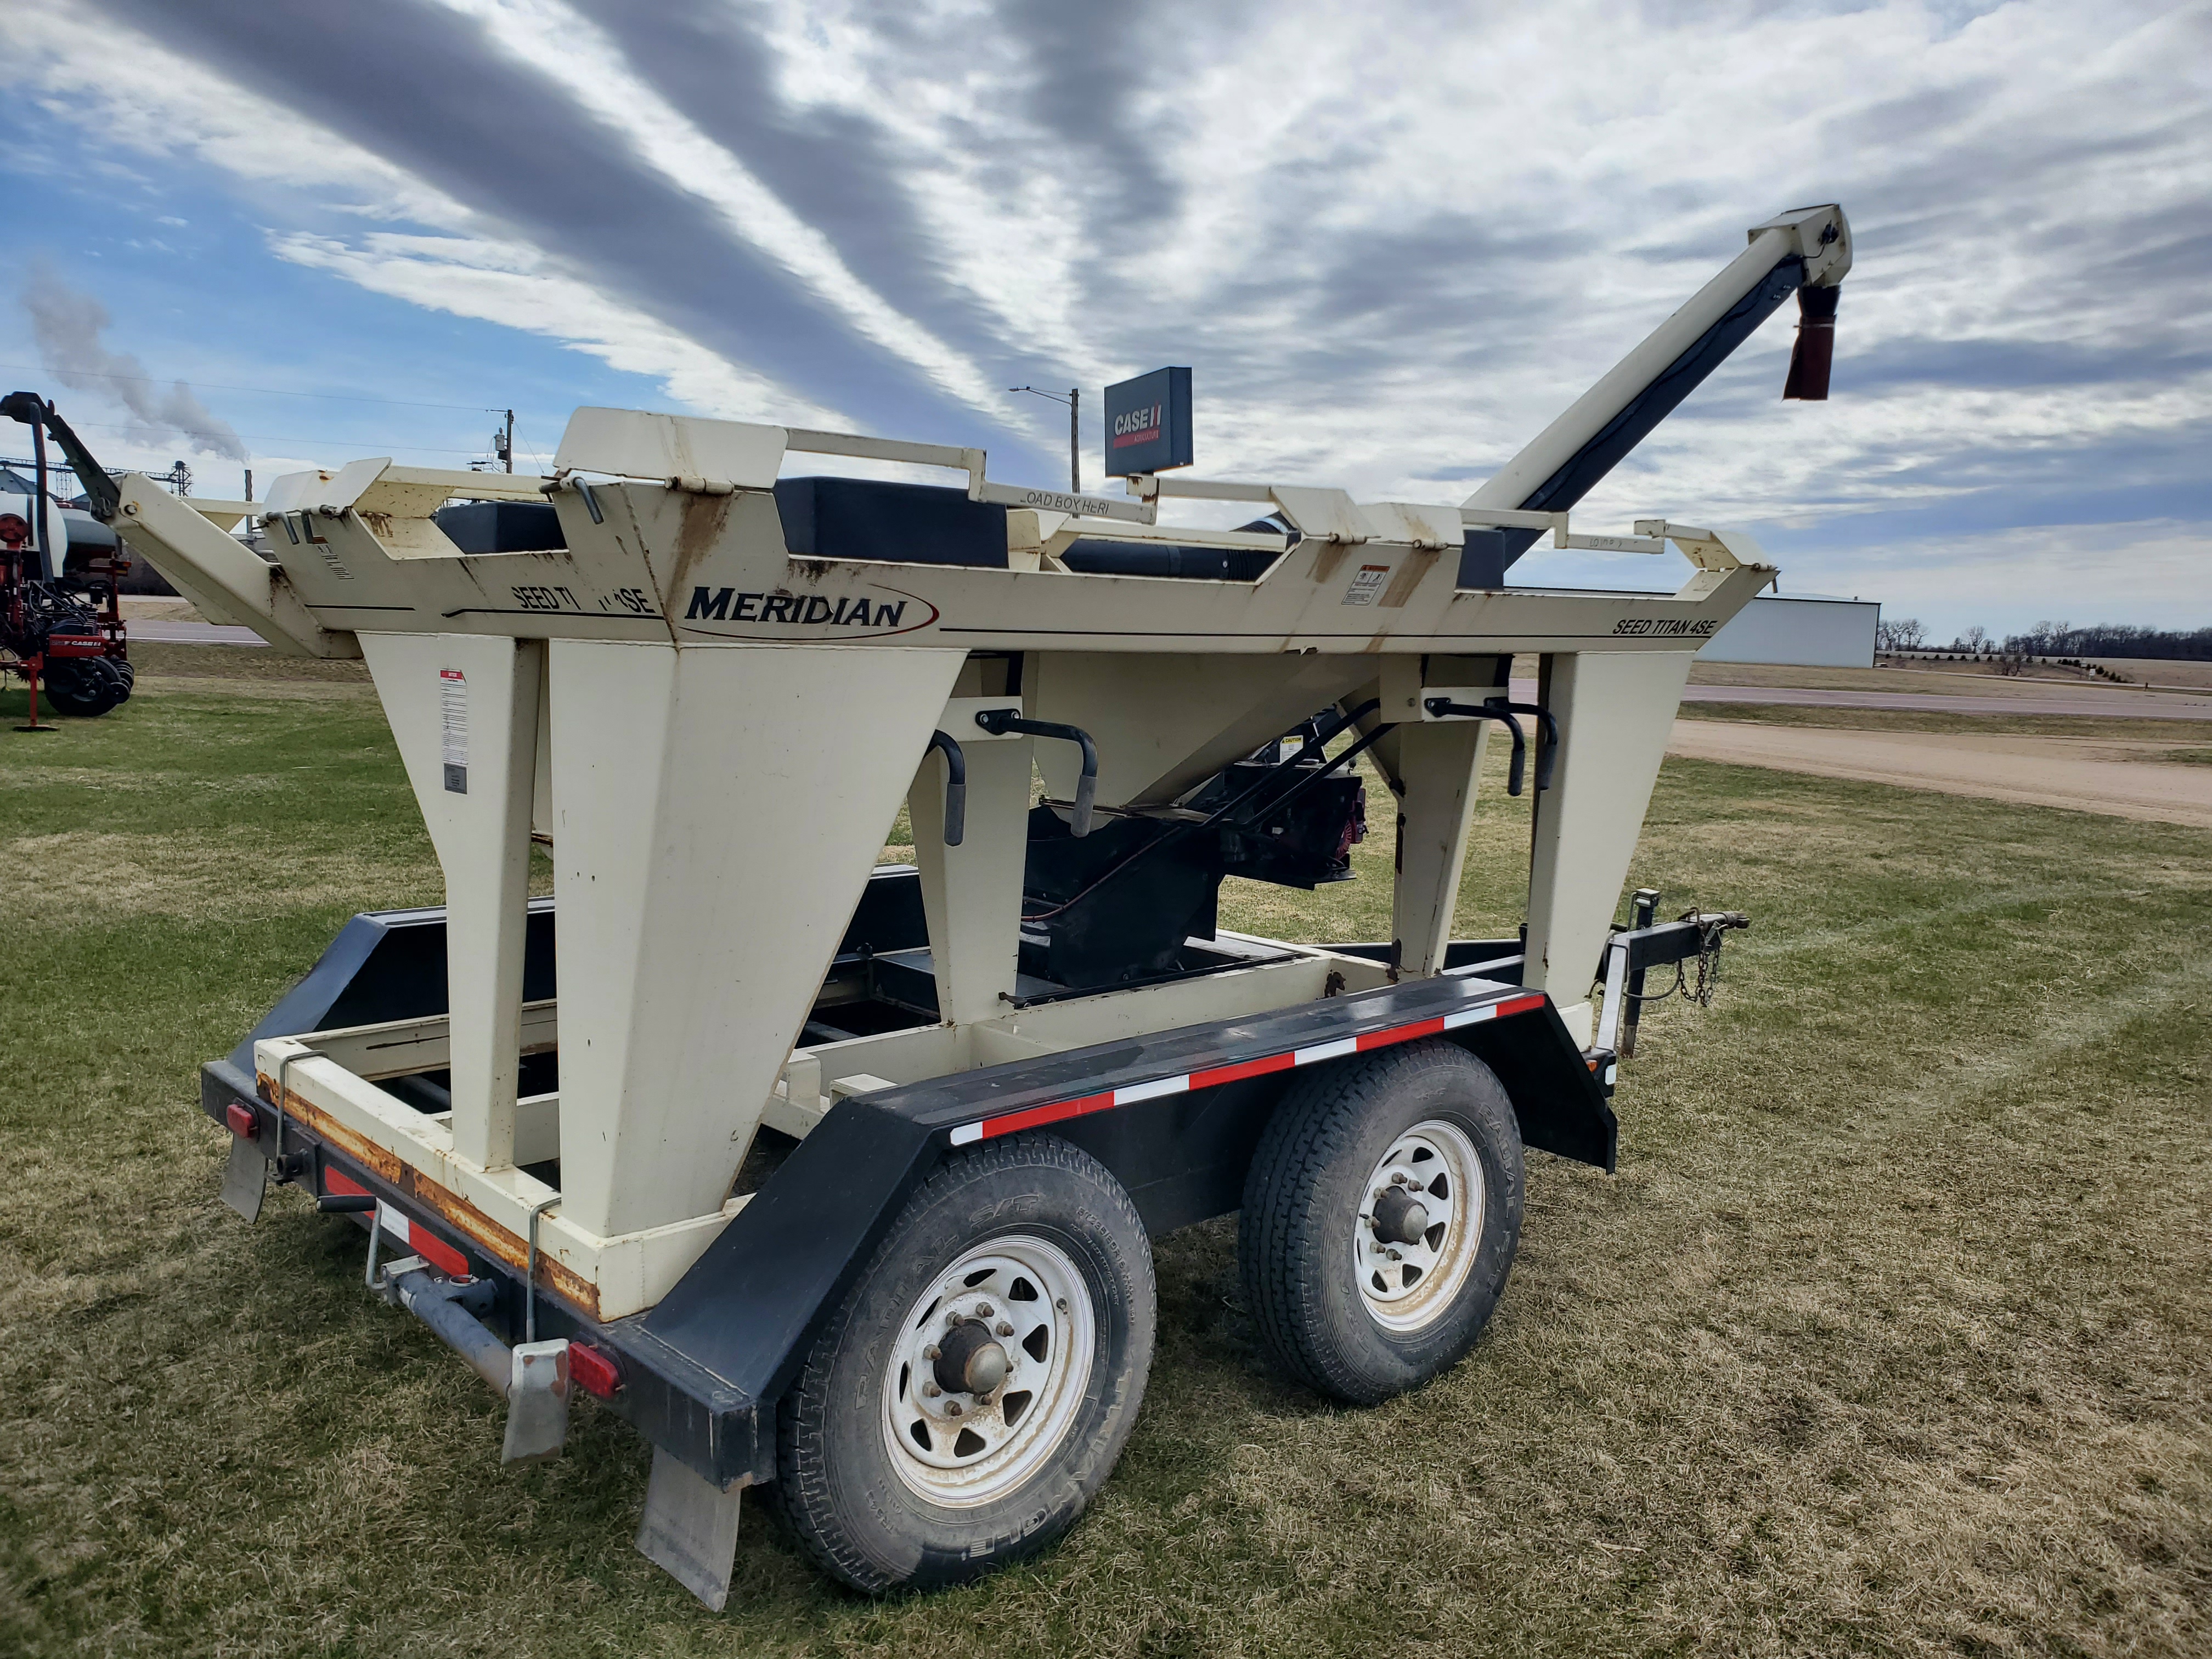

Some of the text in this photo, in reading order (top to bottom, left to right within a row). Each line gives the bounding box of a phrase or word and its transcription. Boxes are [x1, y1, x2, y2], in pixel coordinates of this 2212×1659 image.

[1115, 408, 1149, 436] CASE
[1020, 492, 1052, 507] OAD
[511, 586, 560, 610] SEED
[684, 586, 908, 627] MERIDIAN
[1612, 619, 1718, 634] SEED TITAN 4SE
[1479, 1103, 1515, 1218] RADIAL
